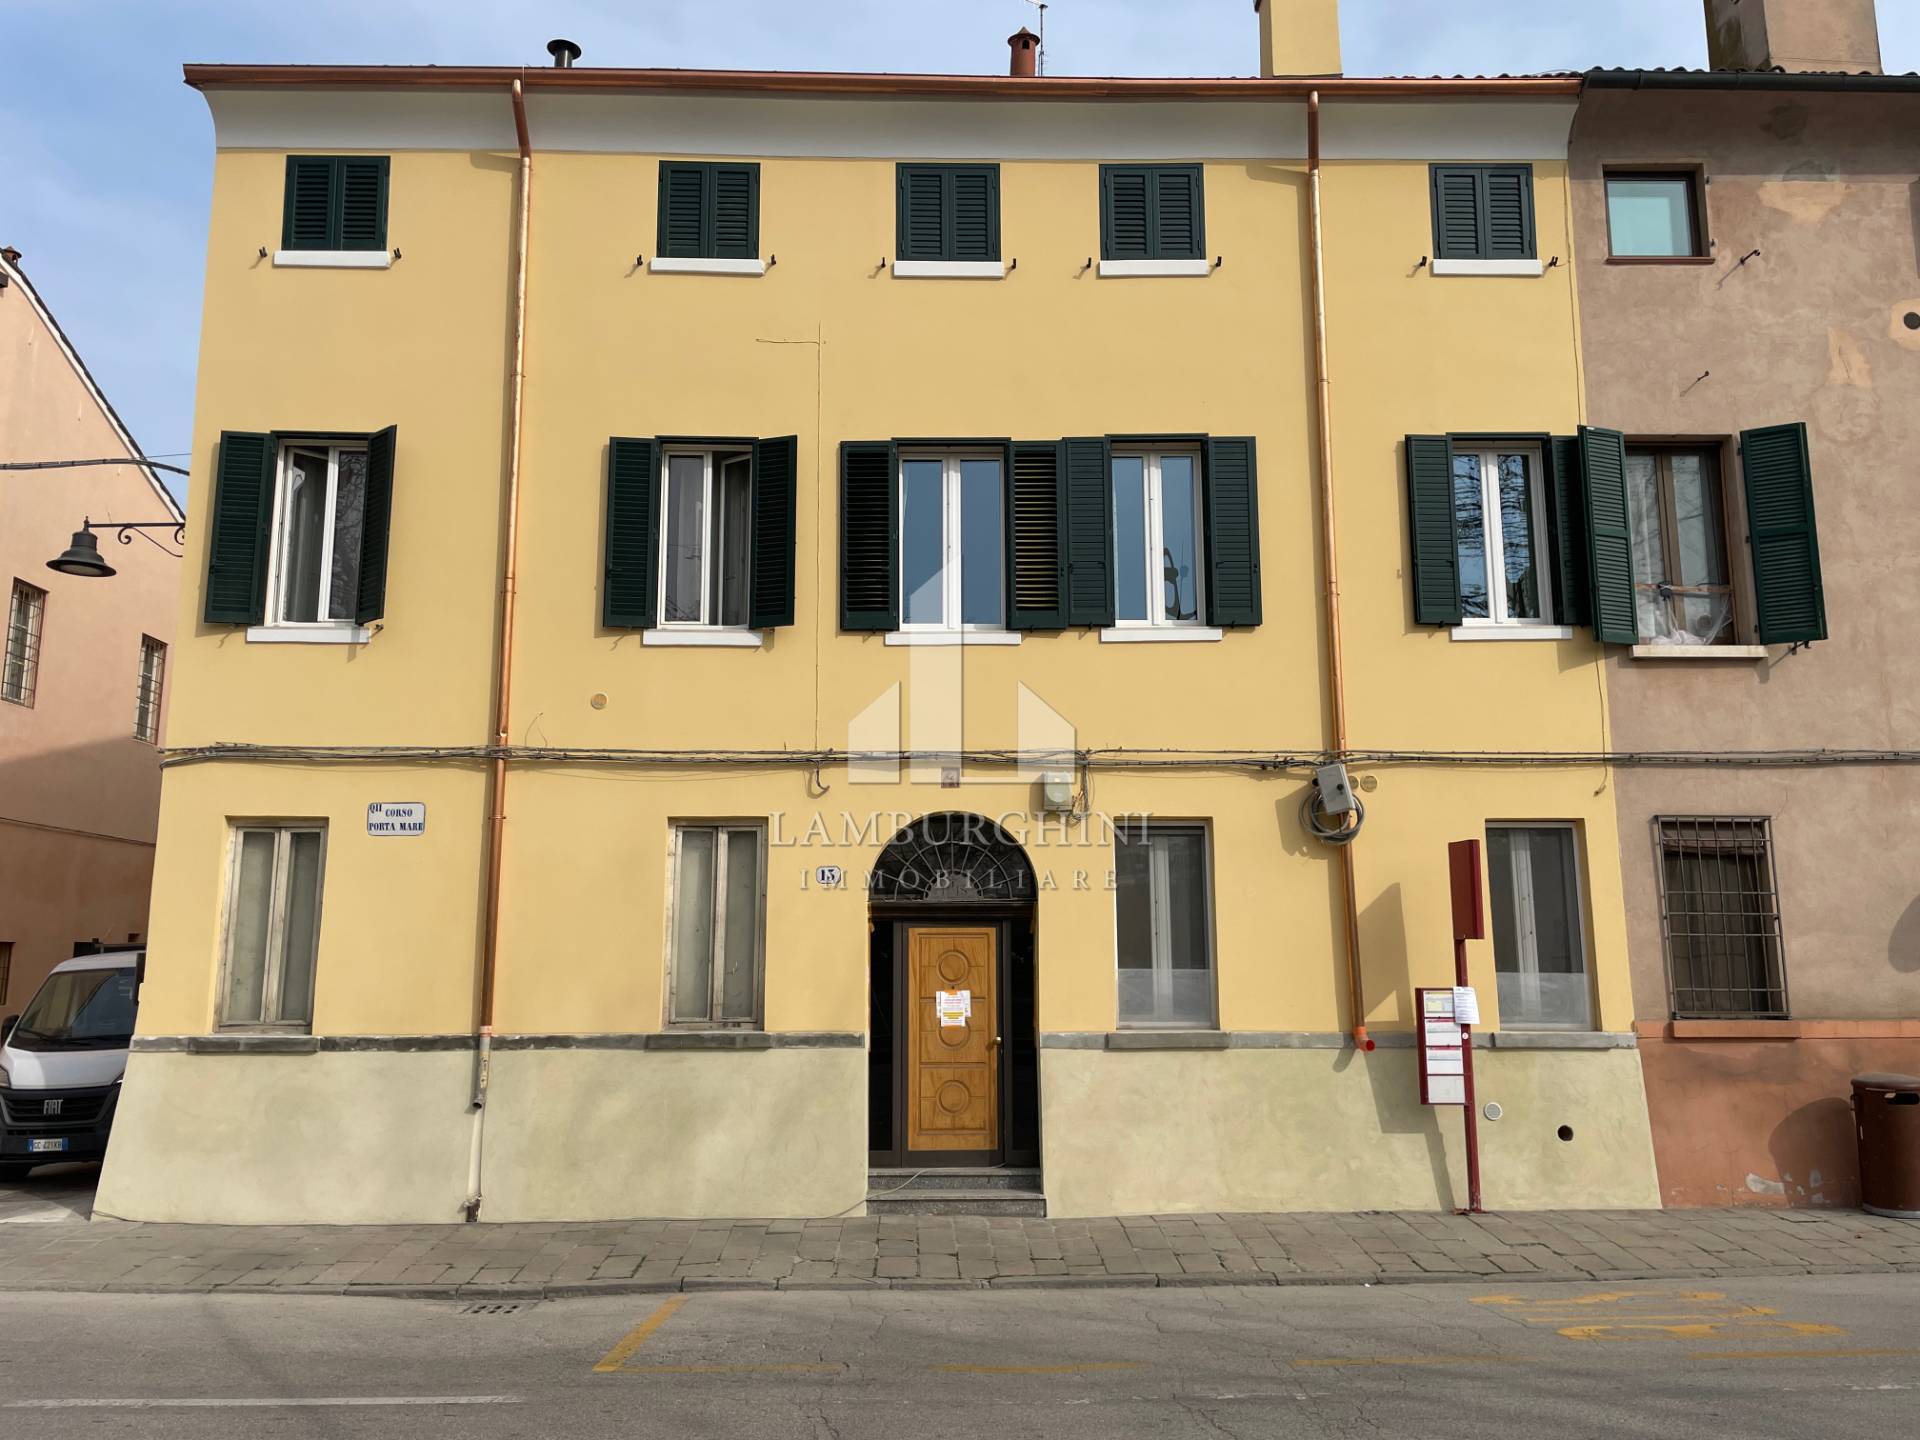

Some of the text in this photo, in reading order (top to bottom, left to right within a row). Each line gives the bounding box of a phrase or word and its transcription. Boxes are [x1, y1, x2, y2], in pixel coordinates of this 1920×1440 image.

[385, 808, 413, 817] CORSO
[368, 822, 424, 831] PORTA MARE
[43, 1099, 64, 1115] FIAT
